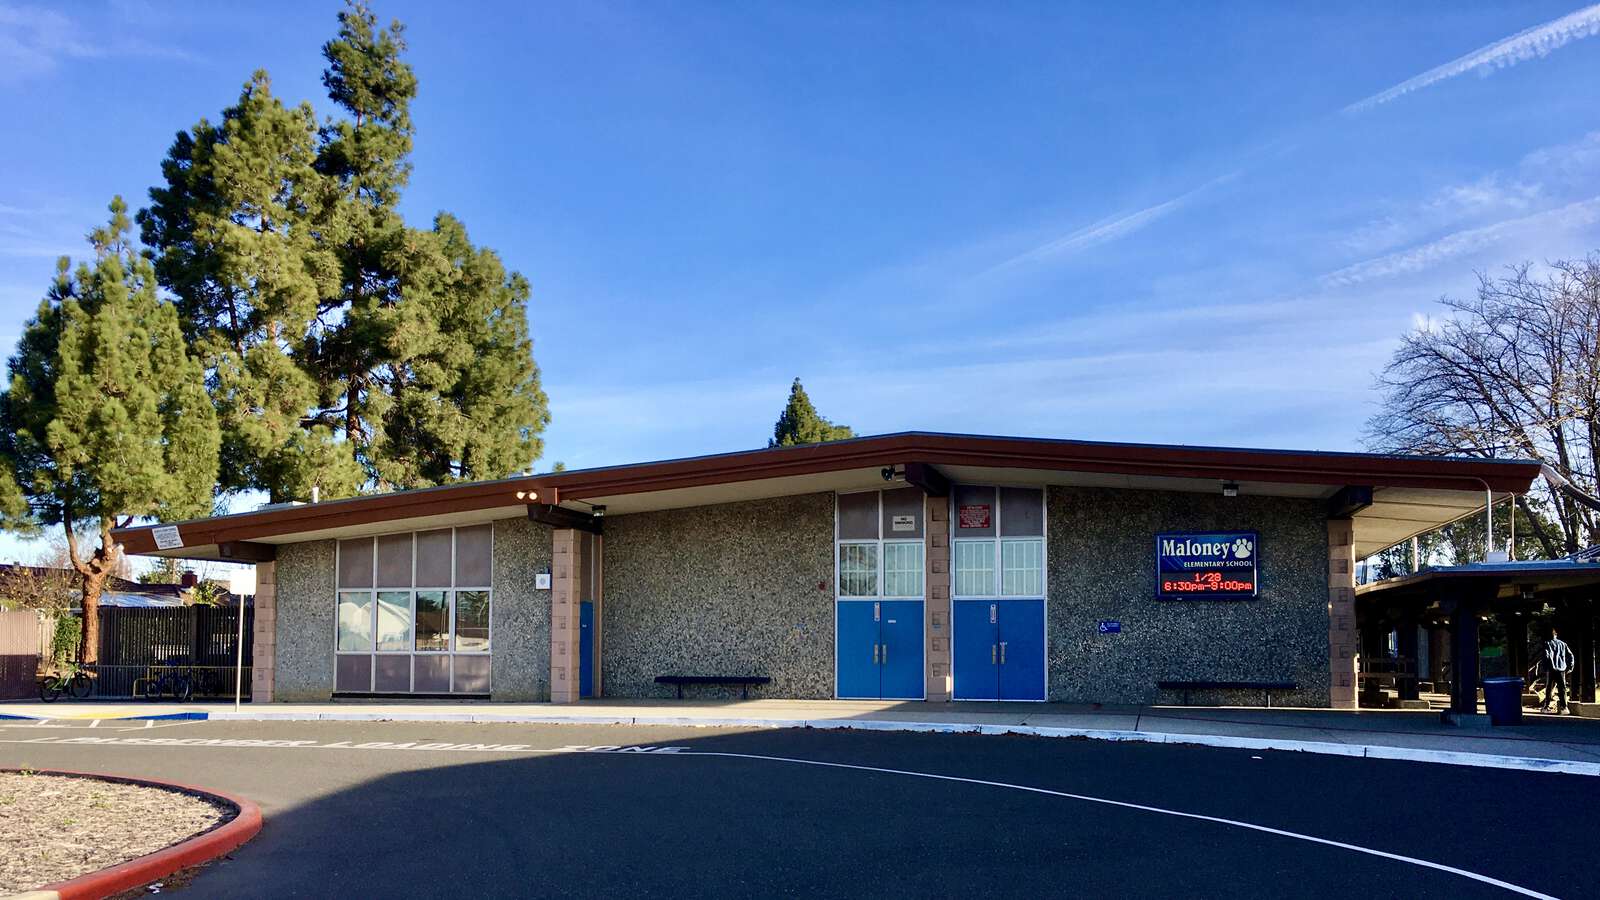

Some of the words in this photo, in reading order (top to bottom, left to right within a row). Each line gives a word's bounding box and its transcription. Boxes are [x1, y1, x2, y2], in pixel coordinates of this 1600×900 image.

[1161, 539, 1230, 559] Maloney
[1194, 573, 1222, 582] 1/28
[323, 740, 532, 751] LOADING
[550, 744, 692, 754] ZONE
